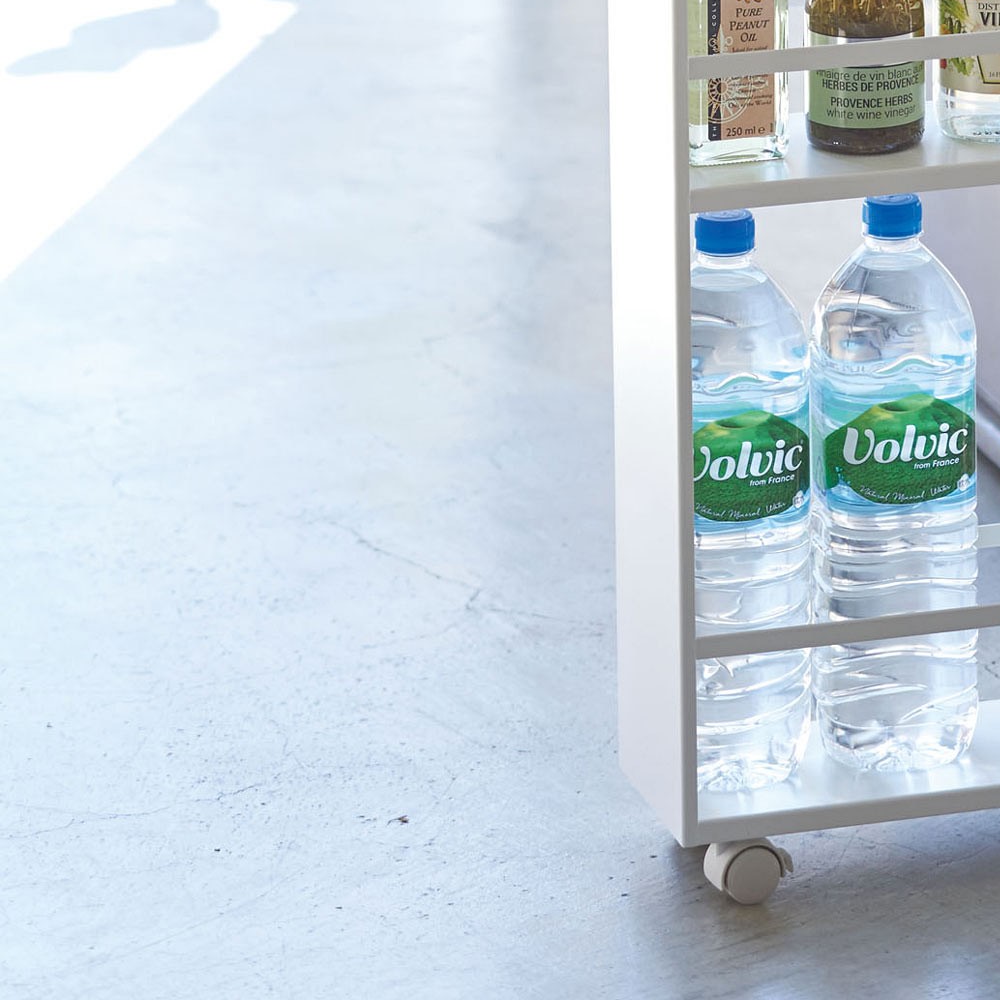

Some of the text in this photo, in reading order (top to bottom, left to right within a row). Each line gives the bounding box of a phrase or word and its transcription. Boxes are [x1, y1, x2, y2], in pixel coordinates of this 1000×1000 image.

[735, 7, 763, 18] PURE
[729, 19, 770, 31] PEANUT
[740, 32, 758, 42] OIL
[853, 71, 867, 81] de
[869, 70, 885, 81] vin
[887, 68, 912, 79] blanc
[822, 74, 919, 92] HERBES DE PROVENCE
[830, 92, 913, 109] PROVENCE HERBS
[826, 104, 916, 120] white wine vinegar
[726, 127, 743, 137] 250
[745, 125, 756, 135] ml
[843, 422, 969, 466] Volvic
[913, 456, 960, 470] from France
[749, 473, 796, 487] from France
